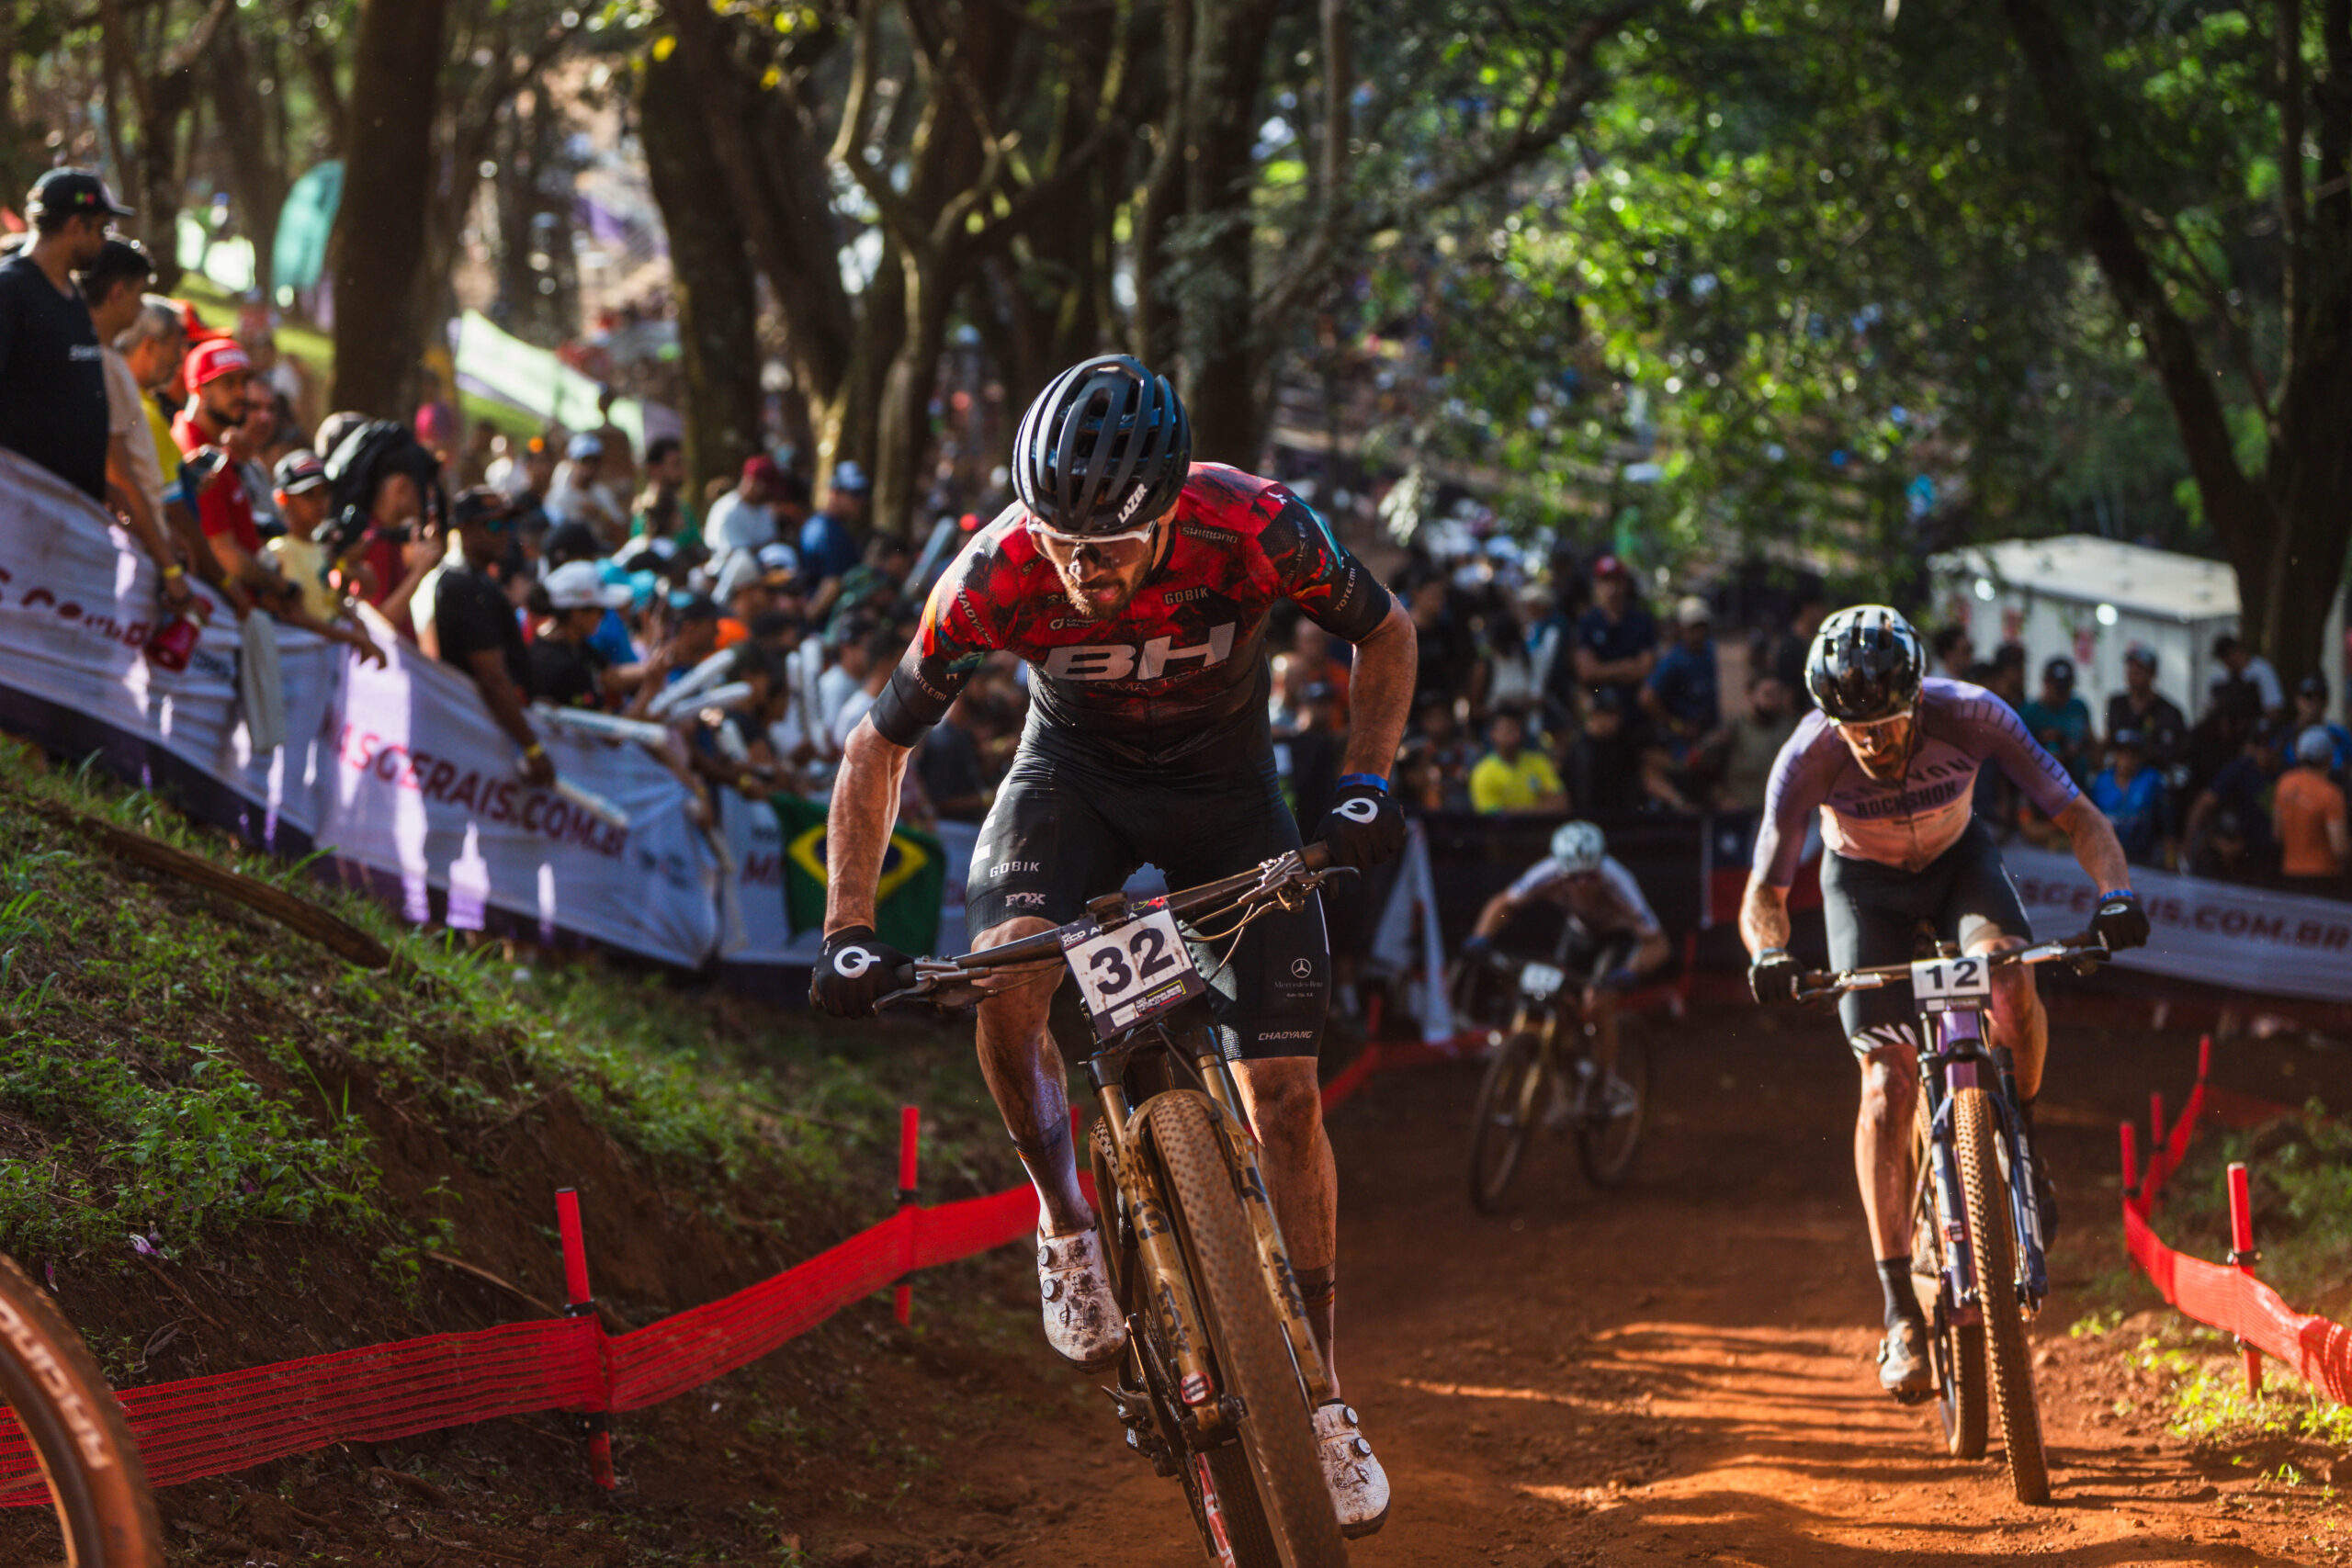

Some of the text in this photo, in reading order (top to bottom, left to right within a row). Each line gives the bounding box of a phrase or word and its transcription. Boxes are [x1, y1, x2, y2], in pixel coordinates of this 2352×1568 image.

[1117, 483, 1148, 524] LAZER
[1165, 586, 1209, 604] GOBIK
[1042, 621, 1236, 681] BH
[1855, 781, 1958, 817] ROCKSHOX
[989, 861, 1040, 878] GOBIK
[1005, 892, 1046, 910] FOX
[1090, 928, 1176, 995] 32
[1925, 960, 1980, 990] 12
[1258, 1031, 1314, 1041] CHAOYANG
